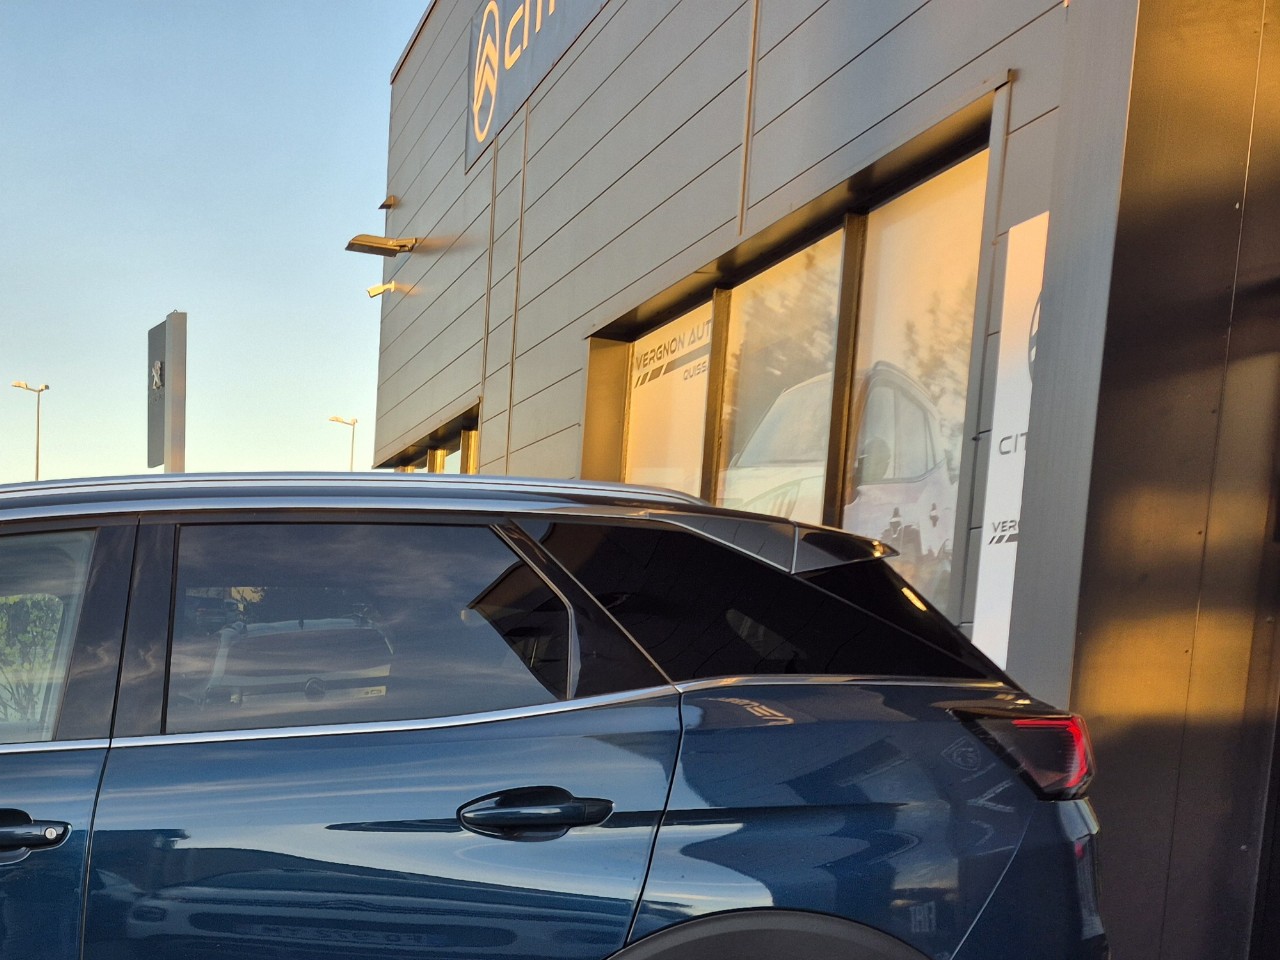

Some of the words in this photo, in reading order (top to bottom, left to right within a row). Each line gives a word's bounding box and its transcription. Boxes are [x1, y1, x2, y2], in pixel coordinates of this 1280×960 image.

[635, 332, 686, 371] VERGNON
[682, 360, 709, 381] QUISS
[991, 518, 1020, 534] VER
